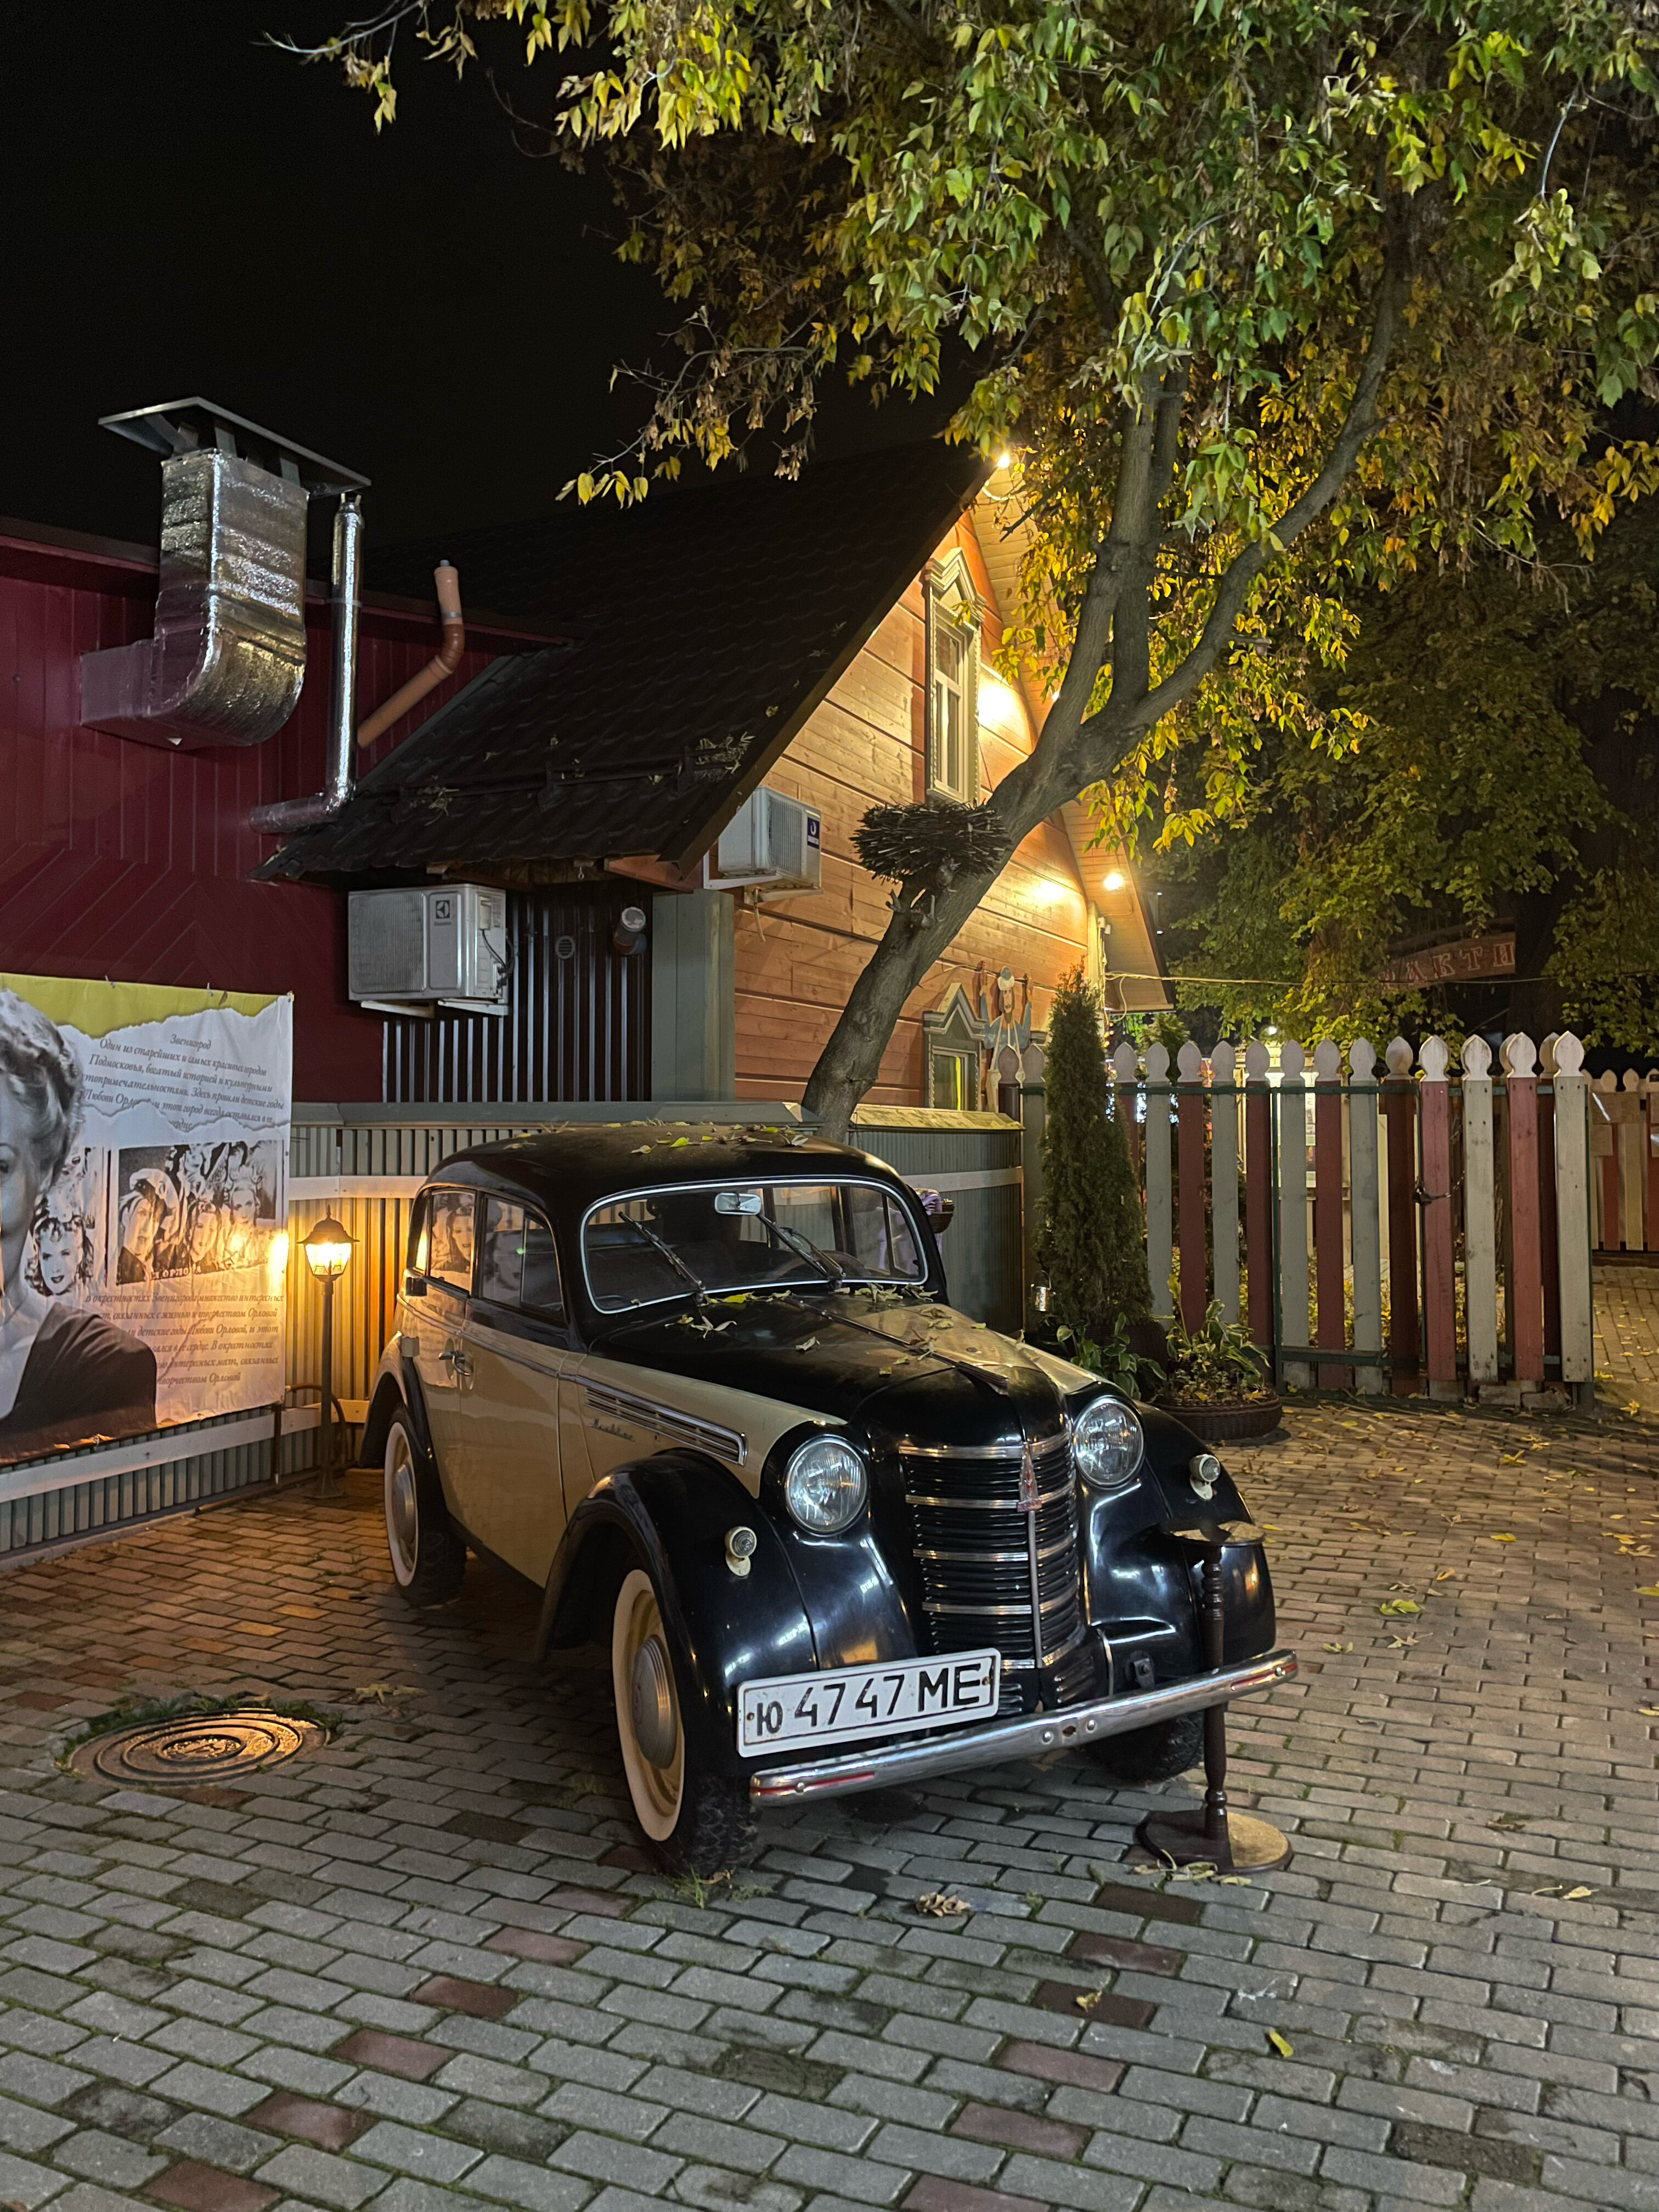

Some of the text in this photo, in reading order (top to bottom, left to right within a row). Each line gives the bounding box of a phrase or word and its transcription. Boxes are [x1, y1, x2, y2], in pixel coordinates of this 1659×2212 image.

[170, 1034, 211, 1052] Звенигород
[100, 1038, 121, 1052] Один
[123, 1045, 133, 1053] из
[134, 1047, 180, 1062] старейших
[188, 1056, 211, 1066] самых
[212, 1060, 244, 1072] красивых
[244, 1065, 267, 1078] городов
[89, 1054, 144, 1074] Подмосковья,
[146, 1063, 182, 1079] богатый
[183, 1071, 218, 1085] историей
[225, 1079, 273, 1093] культурными
[83, 1074, 284, 1109] топримечательностями. Здесь прошли детские годы
[85, 1089, 114, 1103] Любови
[161, 1102, 182, 1112] этот
[183, 1104, 204, 1117] город
[204, 1105, 224, 1117] всегда
[93, 1294, 151, 1306] окрестностях
[152, 1291, 197, 1306] Звенигорода
[239, 1295, 284, 1305] интересных
[248, 1308, 278, 1321] Орловой
[137, 1325, 168, 1336] детские
[170, 1324, 187, 1335] годы
[216, 1324, 247, 1338] Орловой,
[211, 1340, 218, 1350] В
[218, 1341, 273, 1353] окрестностях
[216, 1358, 239, 1367] мест,
[240, 1357, 279, 1365] связанных
[210, 1372, 241, 1386] Орловой
[756, 1702, 783, 1737] Ю
[918, 1662, 982, 1713] МЕ
